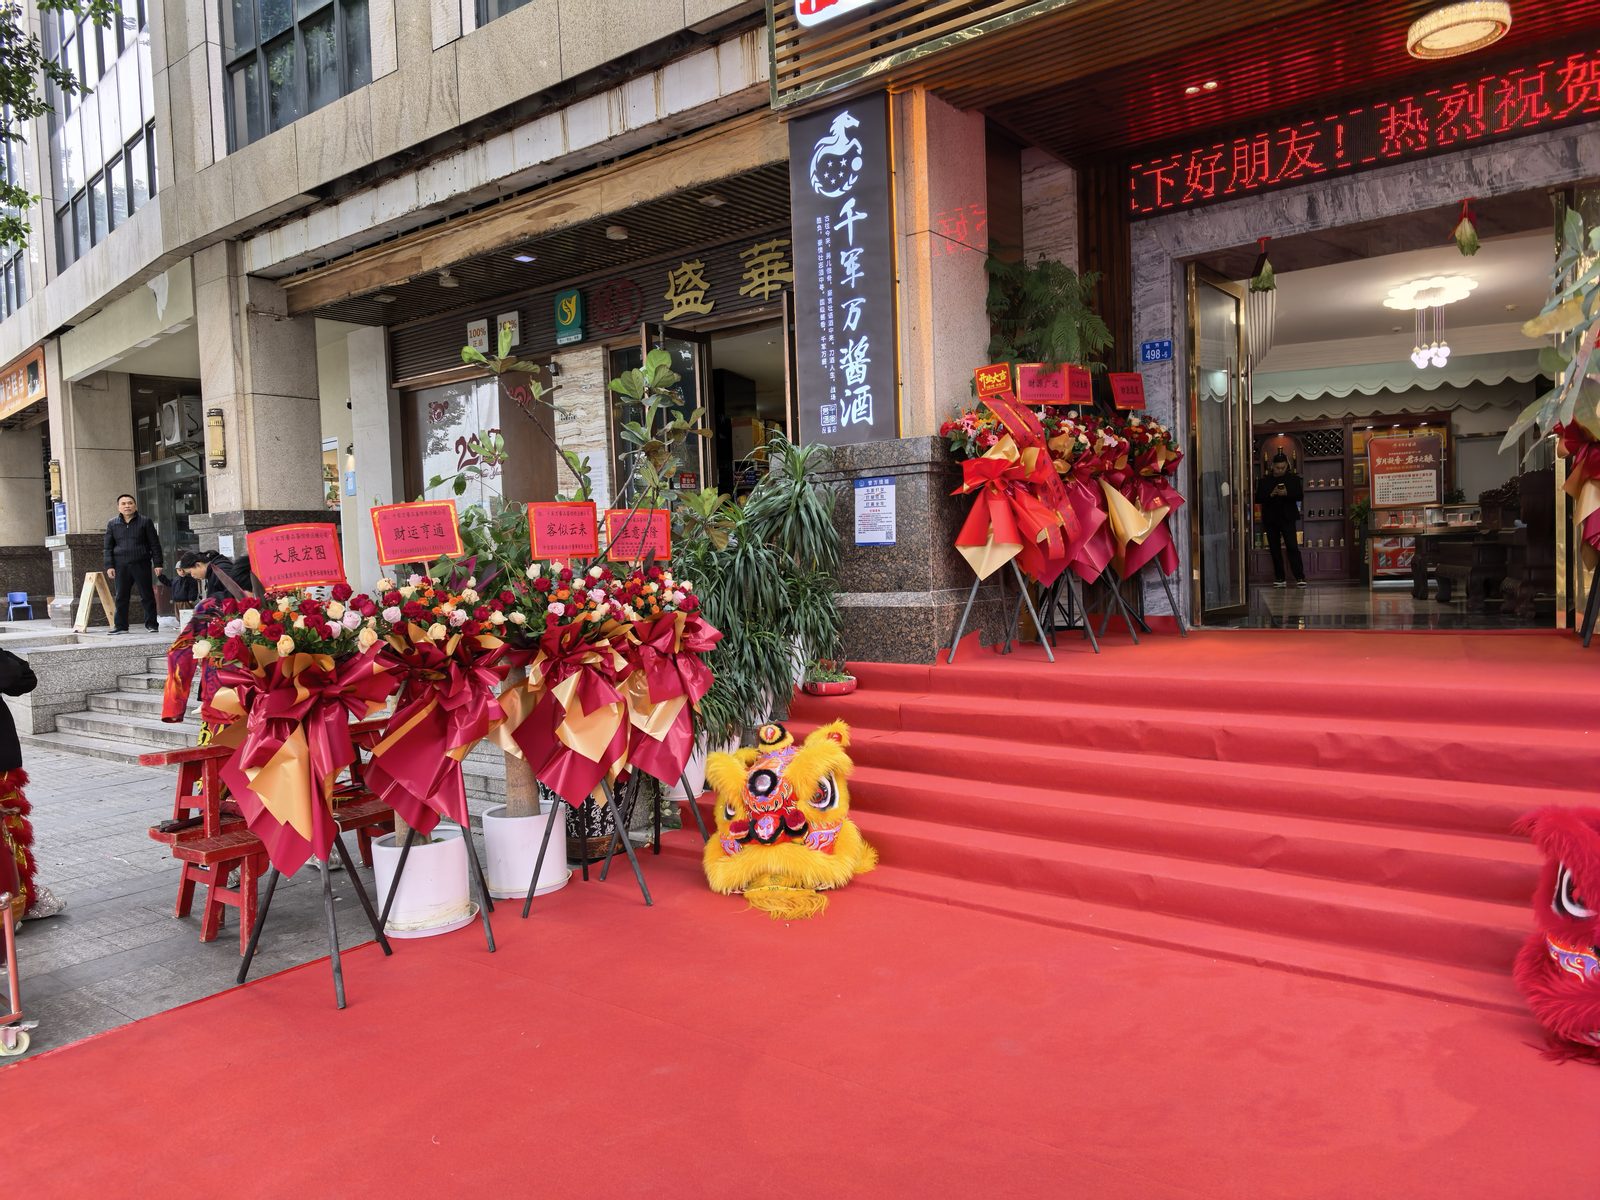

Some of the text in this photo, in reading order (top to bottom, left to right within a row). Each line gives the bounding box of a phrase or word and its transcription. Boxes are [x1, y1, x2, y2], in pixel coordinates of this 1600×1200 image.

[469, 328, 486, 338] 100%
[979, 370, 1007, 389] 开业大吉
[393, 523, 446, 541] 财运亨通
[547, 522, 587, 537] 客似云来
[273, 545, 327, 564] 大展宏图
